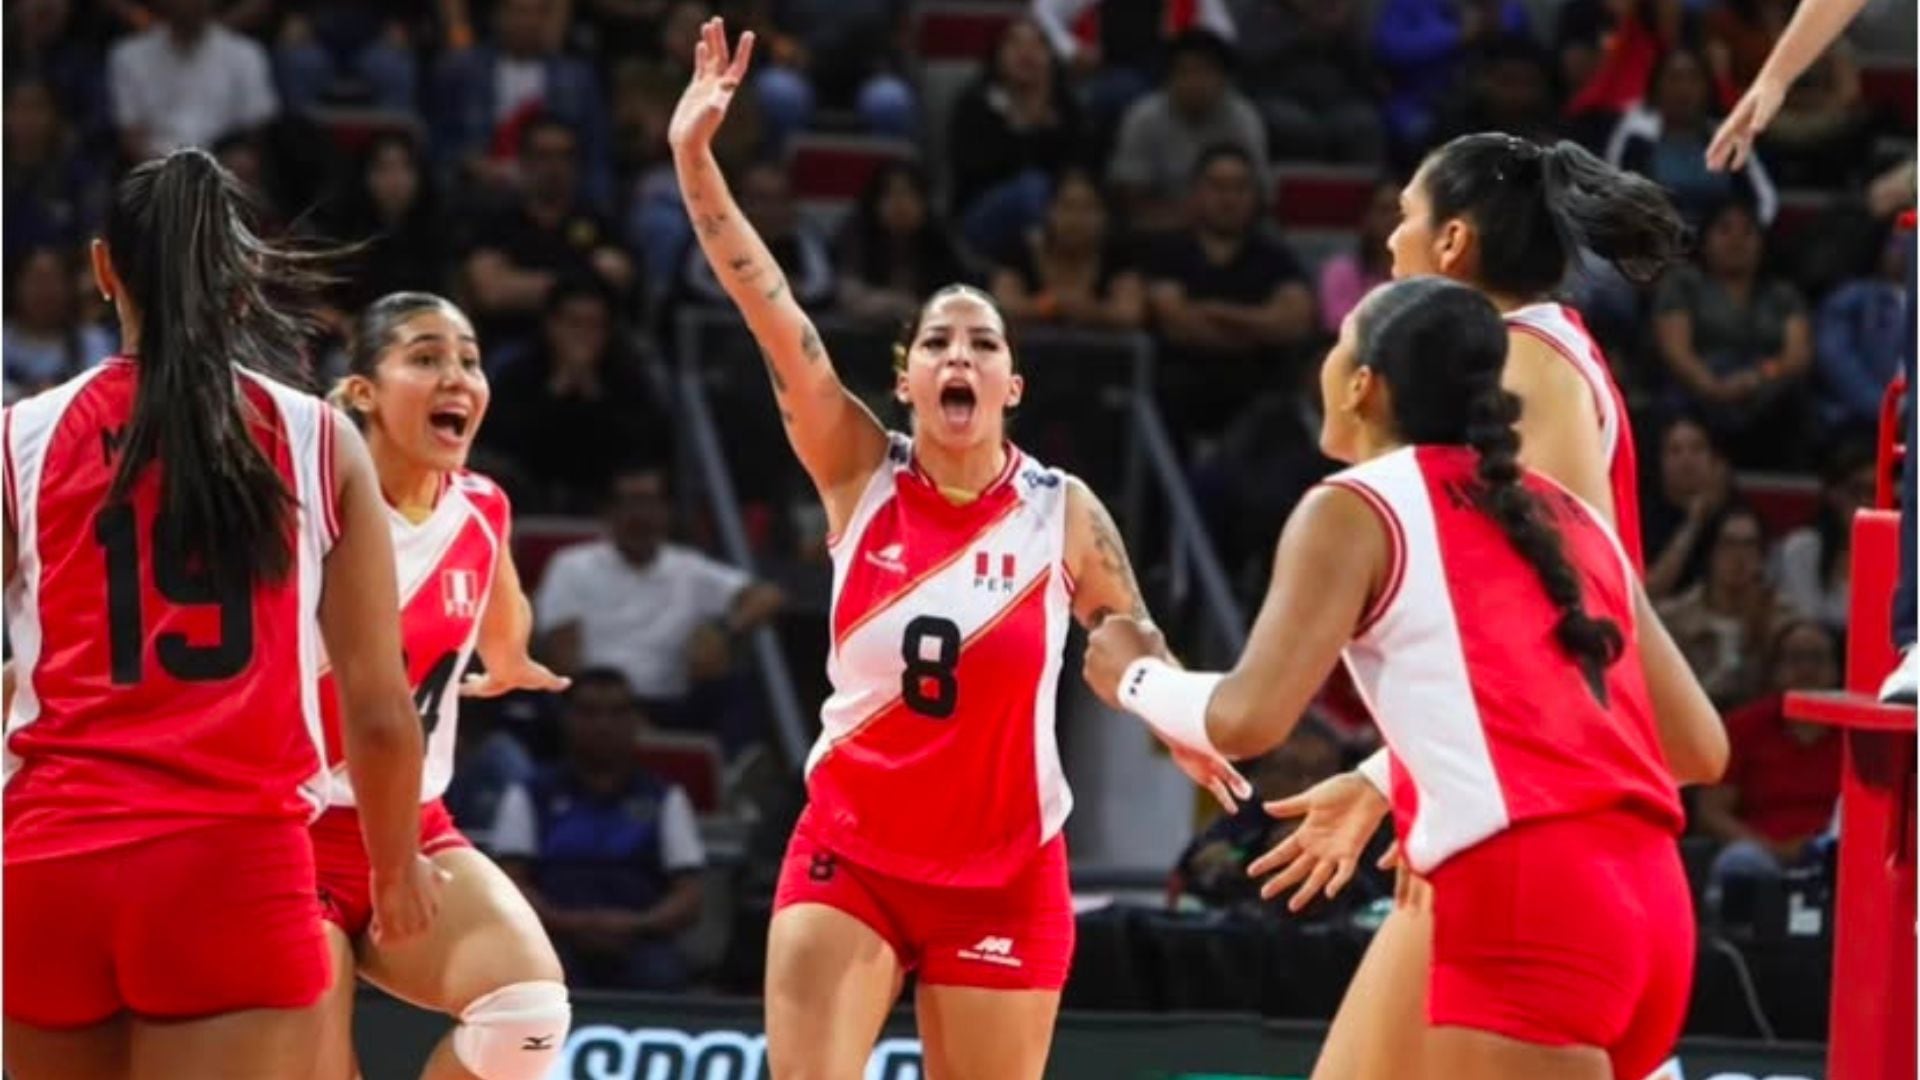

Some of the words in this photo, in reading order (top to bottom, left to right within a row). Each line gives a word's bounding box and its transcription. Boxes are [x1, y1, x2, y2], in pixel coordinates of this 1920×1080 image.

[95, 501, 254, 685] 19
[902, 615, 961, 719] 8
[809, 851, 836, 882] 8
